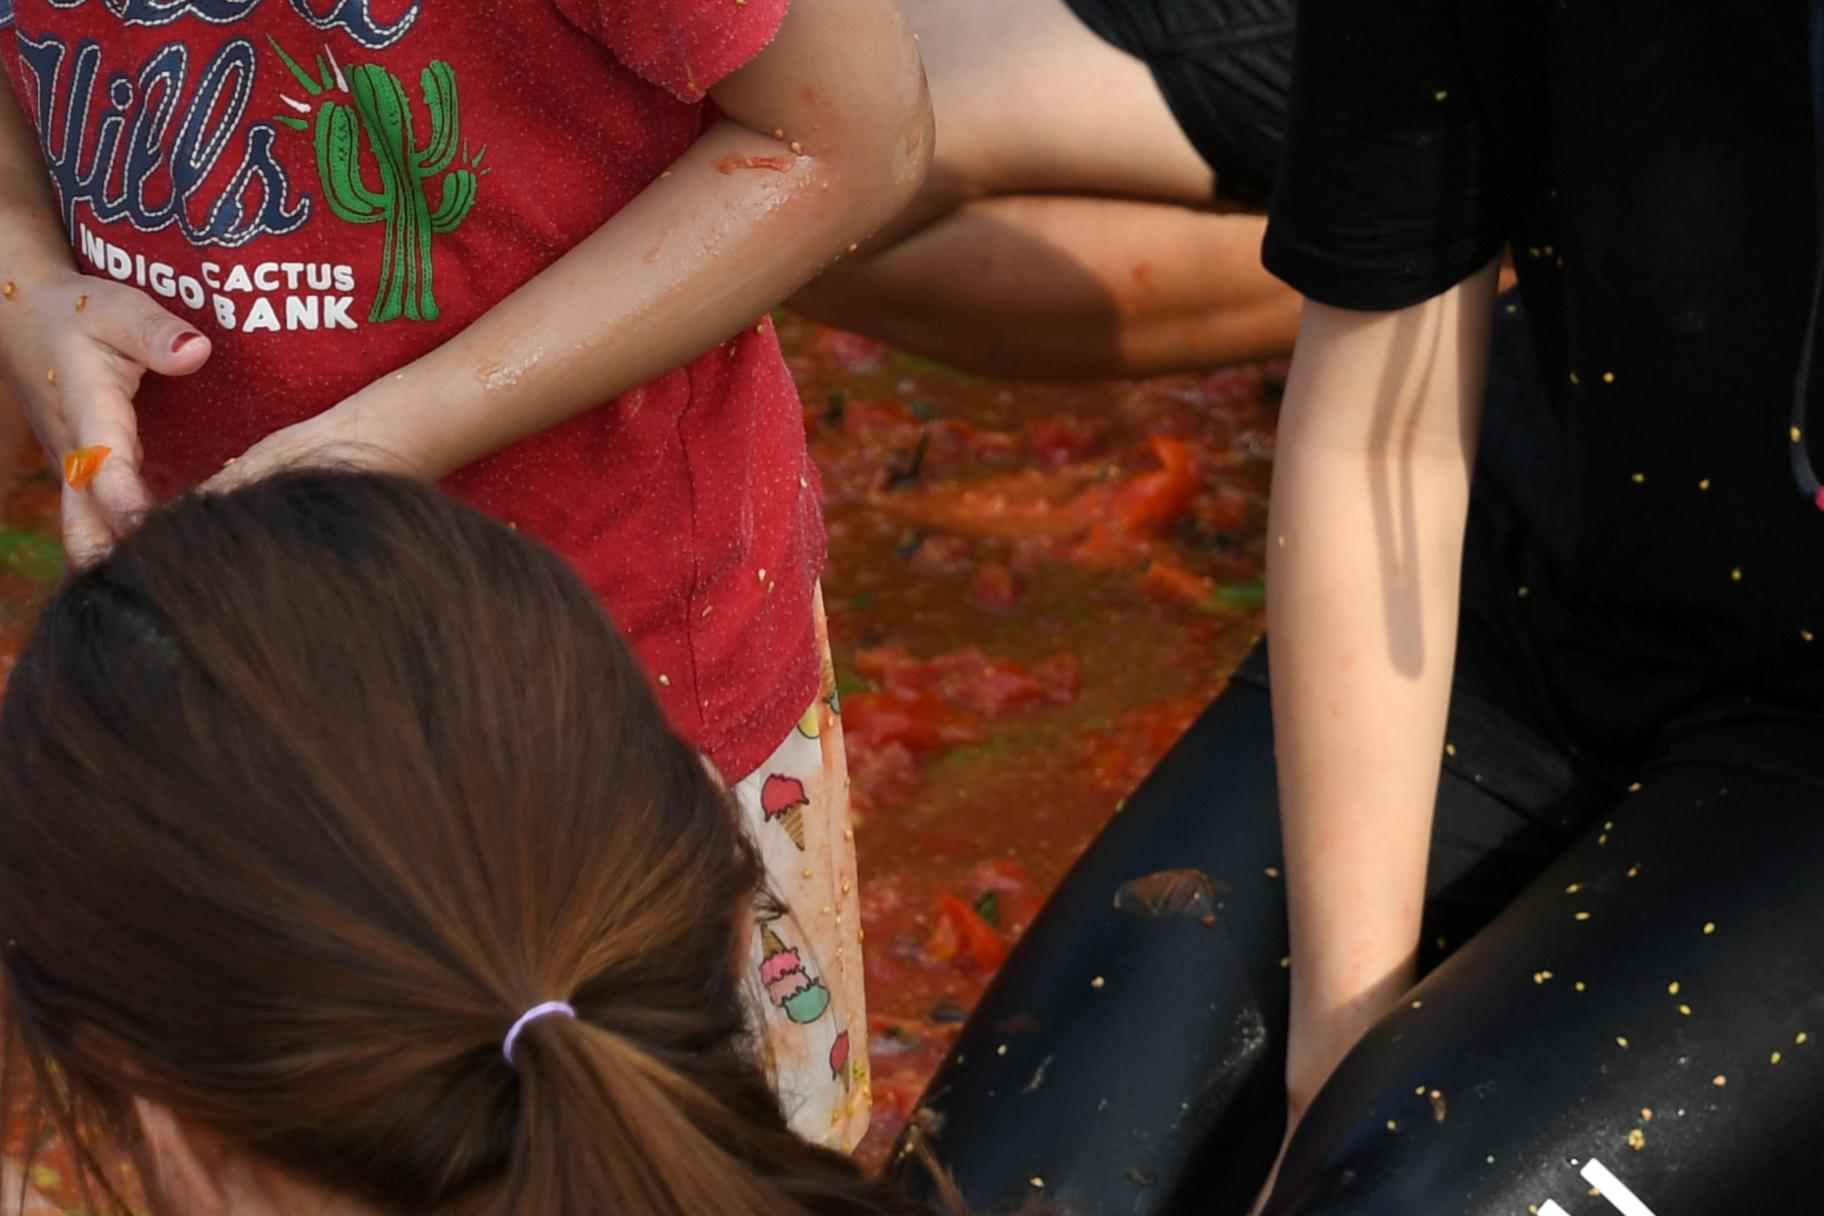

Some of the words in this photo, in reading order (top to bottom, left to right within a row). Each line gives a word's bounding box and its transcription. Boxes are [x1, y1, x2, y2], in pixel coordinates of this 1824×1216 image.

[79, 223, 206, 310] INDIGO
[201, 261, 356, 293] CACTUS
[213, 294, 359, 334] BANK
